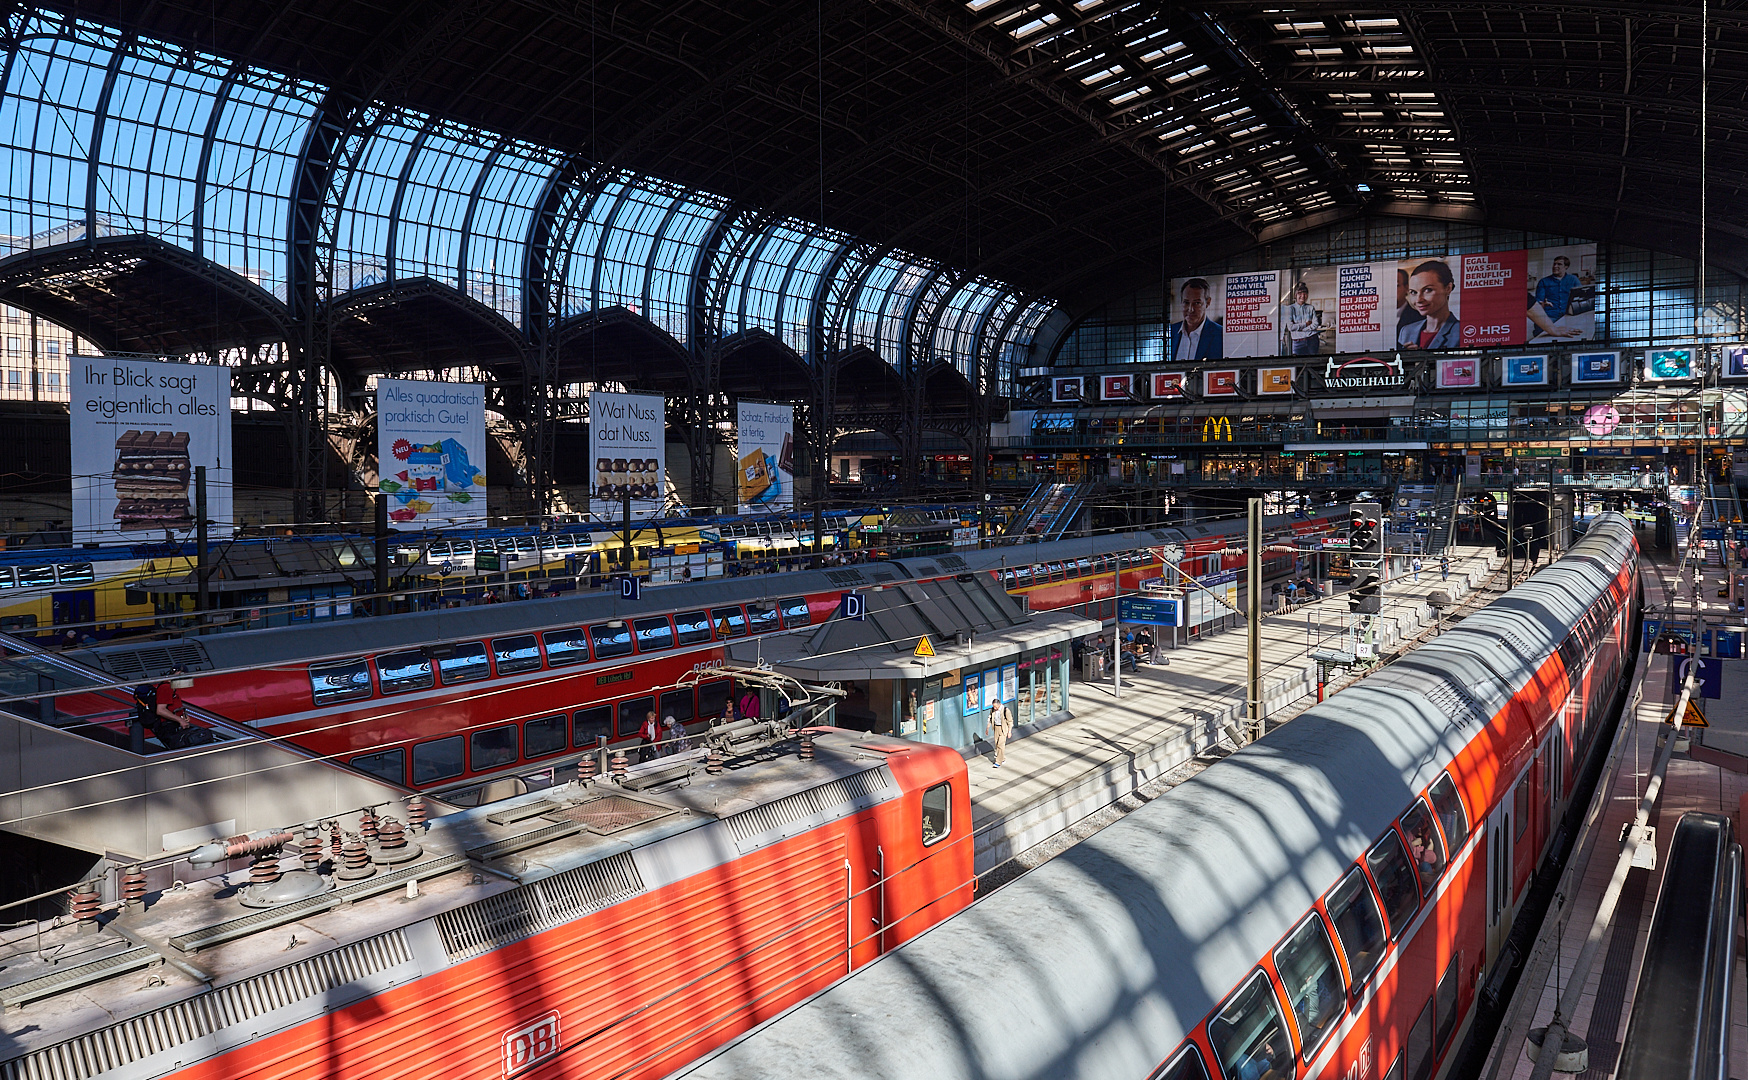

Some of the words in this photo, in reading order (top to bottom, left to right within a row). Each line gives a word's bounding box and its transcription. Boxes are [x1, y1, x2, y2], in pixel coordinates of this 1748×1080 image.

[1466, 270, 1510, 280] BERUFLICH
[1466, 279, 1503, 287] MACHEN:
[1480, 324, 1510, 335] HRS
[85, 364, 107, 384] Ihr
[114, 366, 154, 387] Blick
[160, 375, 197, 395] sagt
[1324, 375, 1405, 388] WANDELHALLE
[385, 386, 413, 402] Alles
[416, 389, 478, 407] quadratisch
[86, 394, 172, 418] eigentlich
[178, 396, 220, 416] alles.
[598, 400, 625, 418] Wat
[628, 403, 657, 423] Nuss,
[385, 407, 434, 426] praktisch
[438, 410, 469, 424] Gute!
[741, 410, 763, 423] Schatz,
[764, 412, 790, 423] Frühstück
[598, 422, 619, 441] dat
[623, 425, 652, 442] Nuss.
[749, 425, 765, 440] fertig.
[395, 446, 409, 454] NEU
[623, 579, 632, 596] D
[847, 596, 859, 616] D
[608, 674, 622, 683] Lübeck
[509, 1021, 553, 1071] DB
